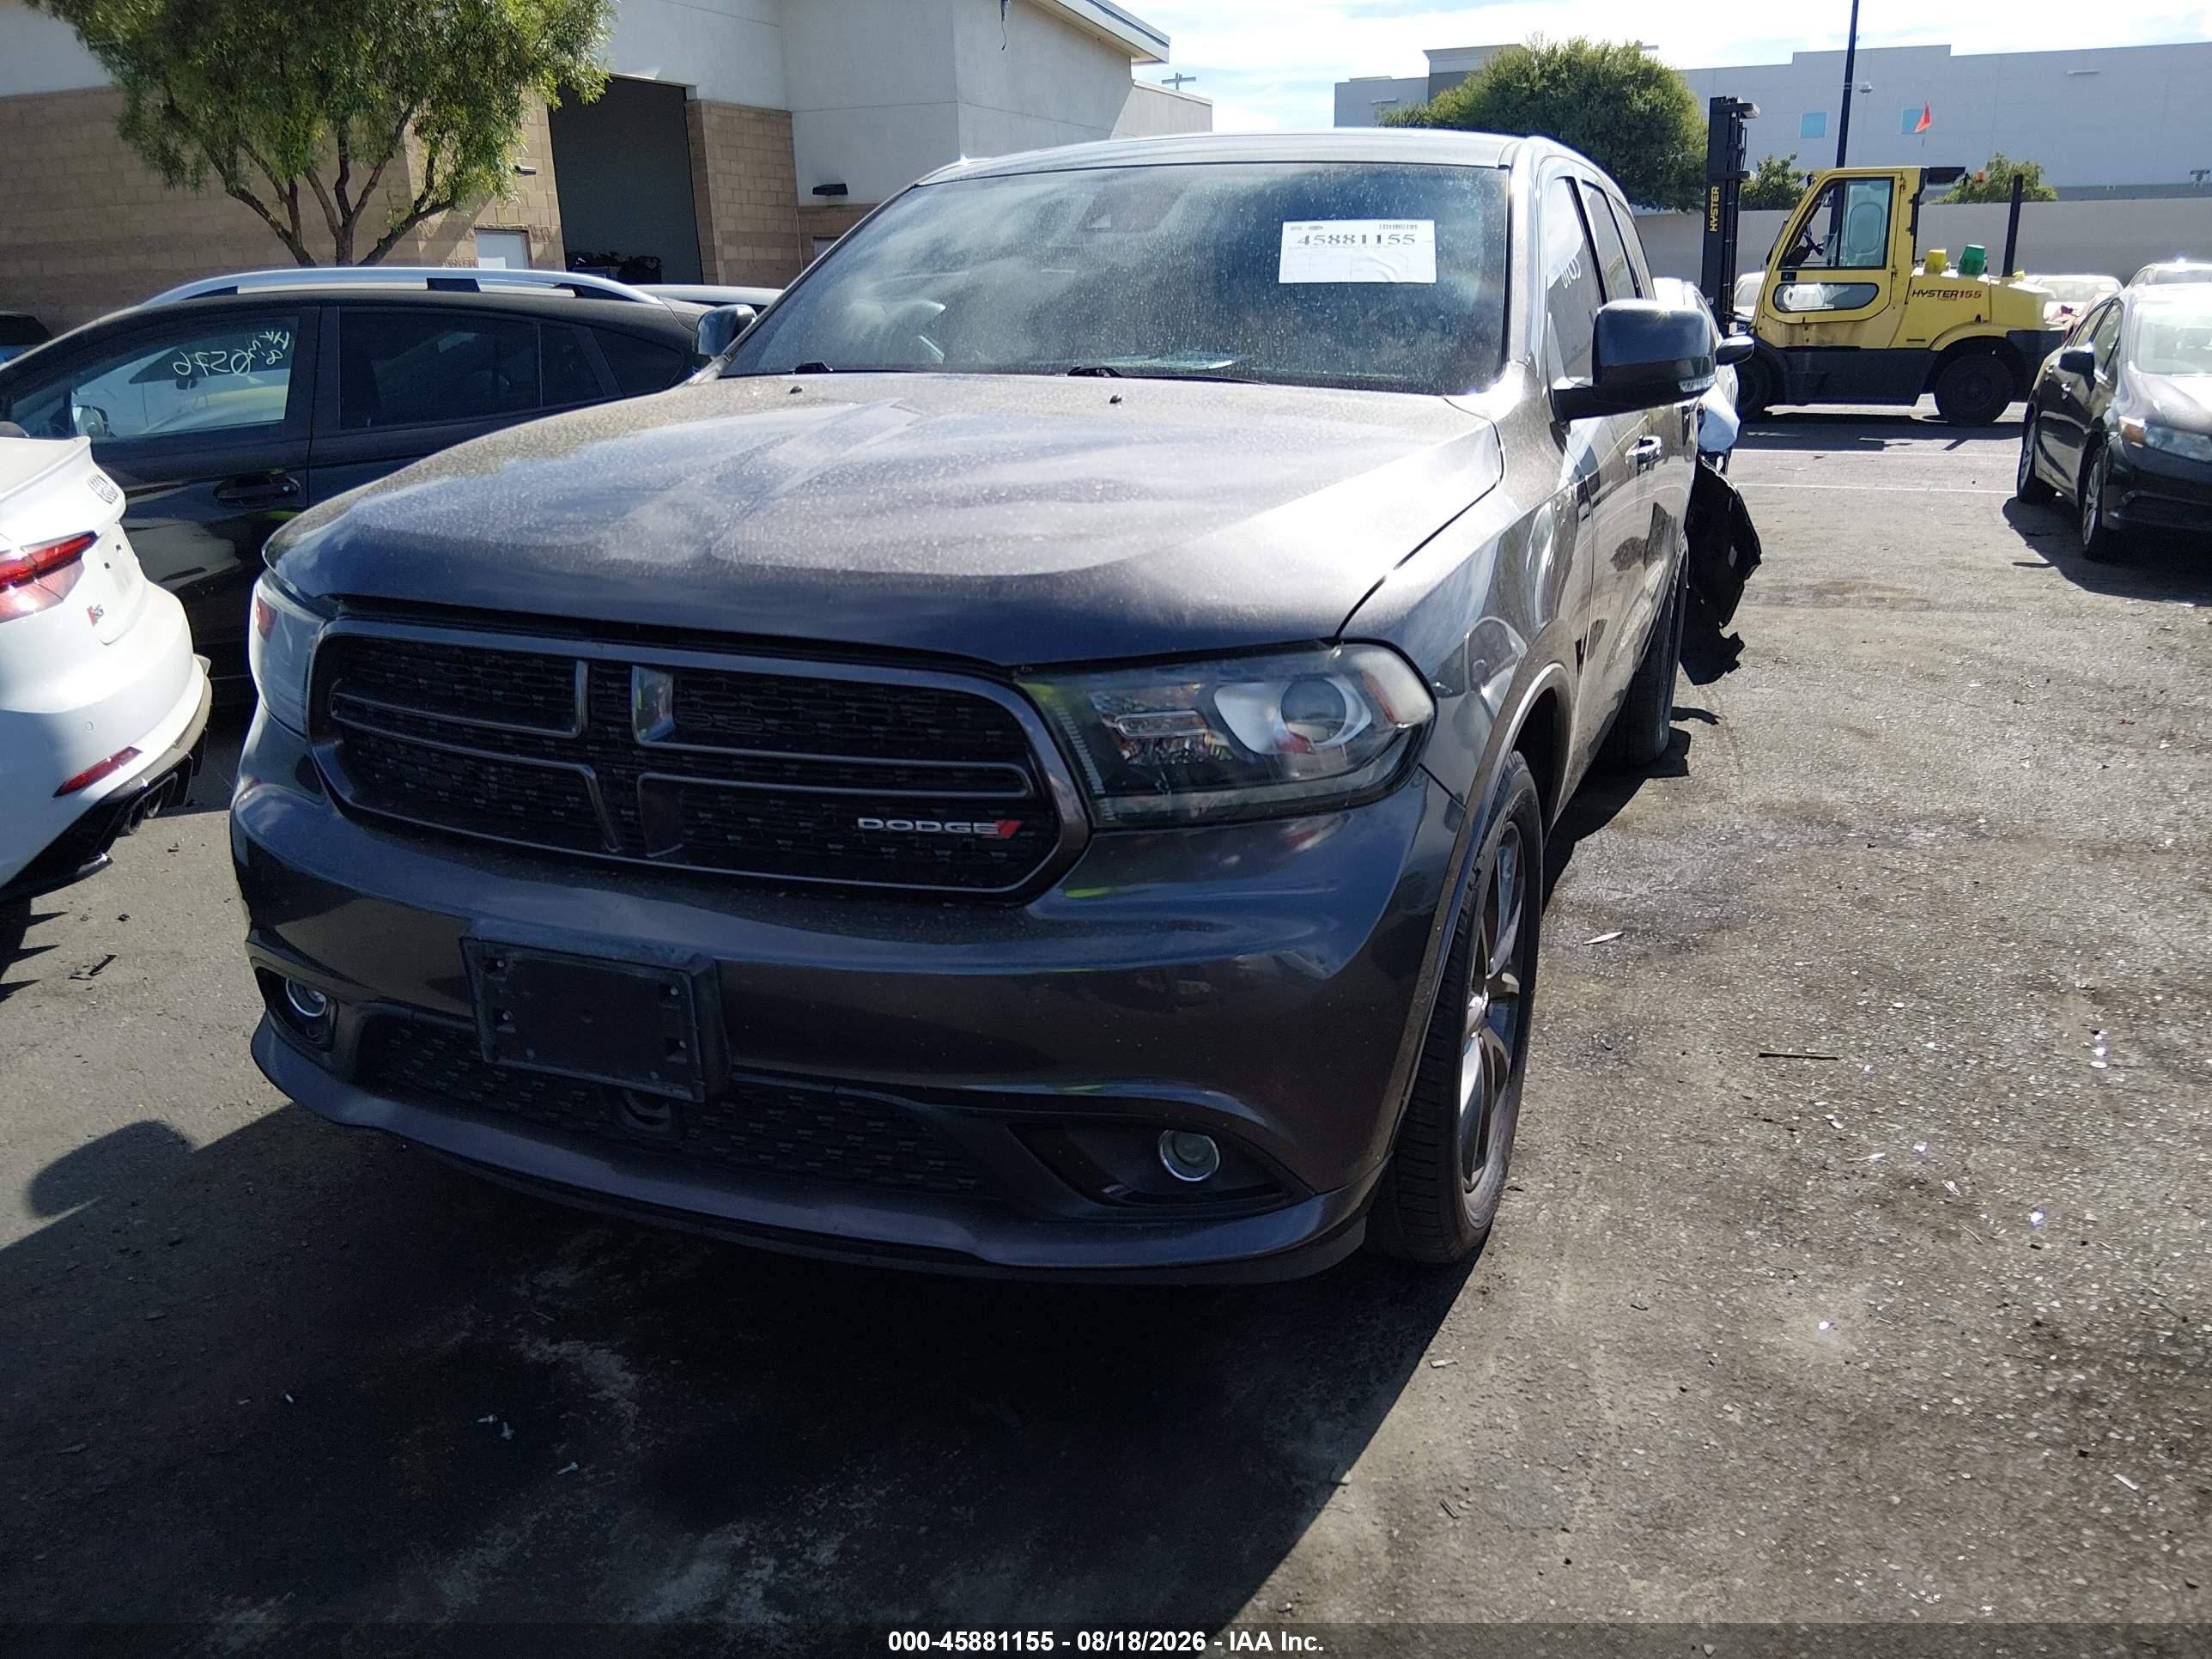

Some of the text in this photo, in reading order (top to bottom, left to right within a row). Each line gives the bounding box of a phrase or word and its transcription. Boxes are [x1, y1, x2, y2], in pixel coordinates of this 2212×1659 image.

[1710, 186, 1719, 232] HYSTER
[1297, 234, 1416, 246] 45881155
[857, 817, 1000, 836] DODGE
